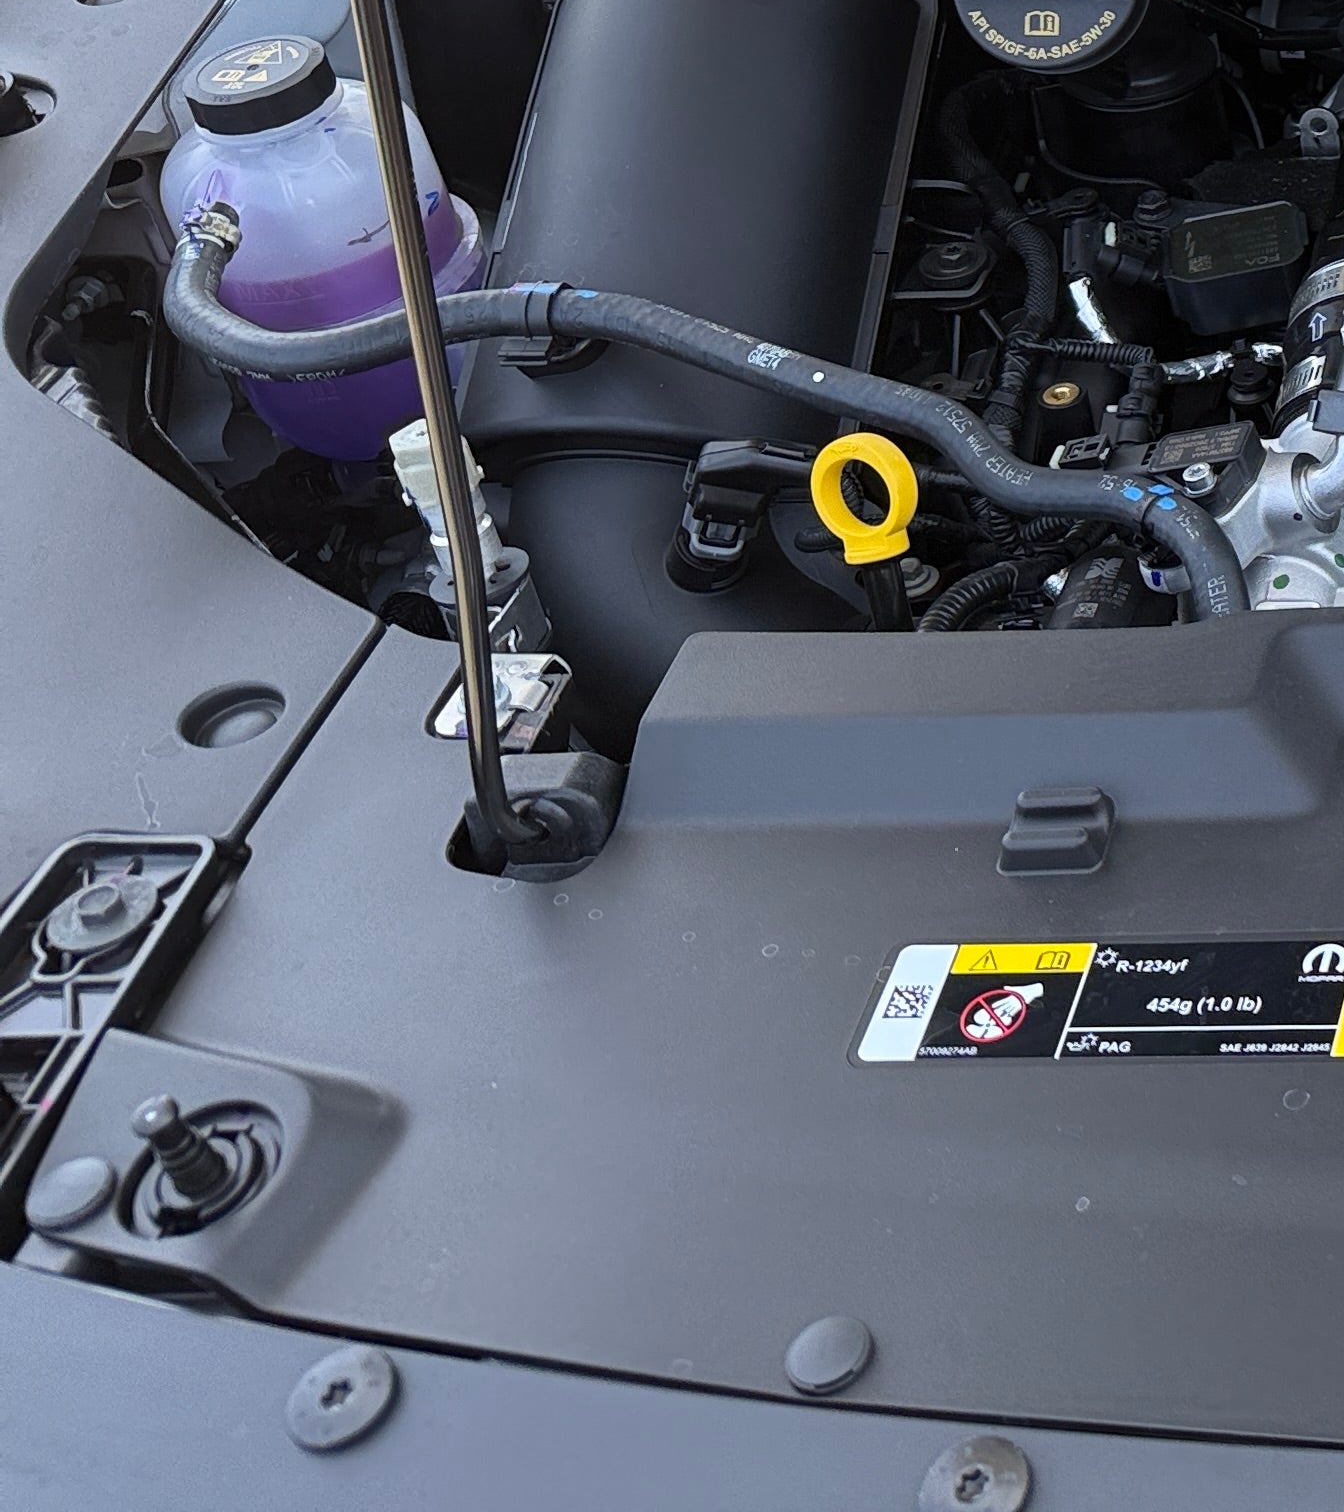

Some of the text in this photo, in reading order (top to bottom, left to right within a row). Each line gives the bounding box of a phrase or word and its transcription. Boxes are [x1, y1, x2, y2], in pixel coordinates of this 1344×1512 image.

[968, 9, 991, 33] API
[1115, 958, 1190, 975] R-1234yf
[1146, 995, 1263, 1015] 454g (1.0 lb)
[1098, 1041, 1132, 1054] PAG
[1219, 1042, 1242, 1053] SAE
